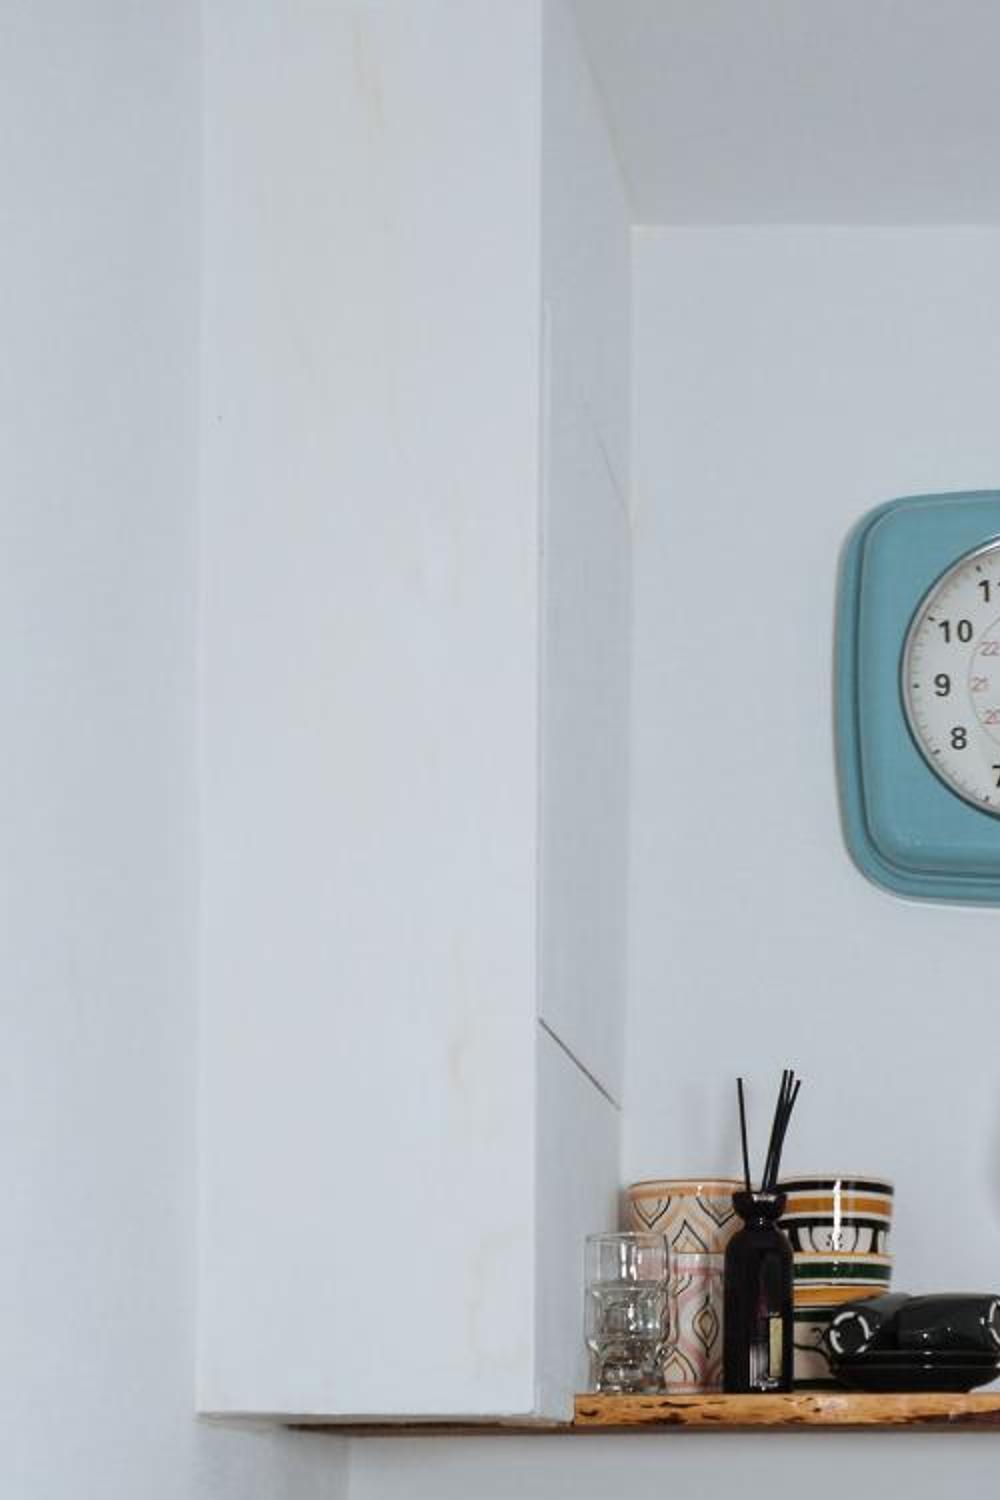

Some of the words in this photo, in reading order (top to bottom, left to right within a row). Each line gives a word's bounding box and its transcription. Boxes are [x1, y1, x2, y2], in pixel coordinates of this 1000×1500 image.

[938, 619, 973, 644] 10
[980, 640, 1000, 656] 22
[933, 673, 951, 697] 9
[971, 676, 990, 693] 21
[950, 726, 968, 751] 8
